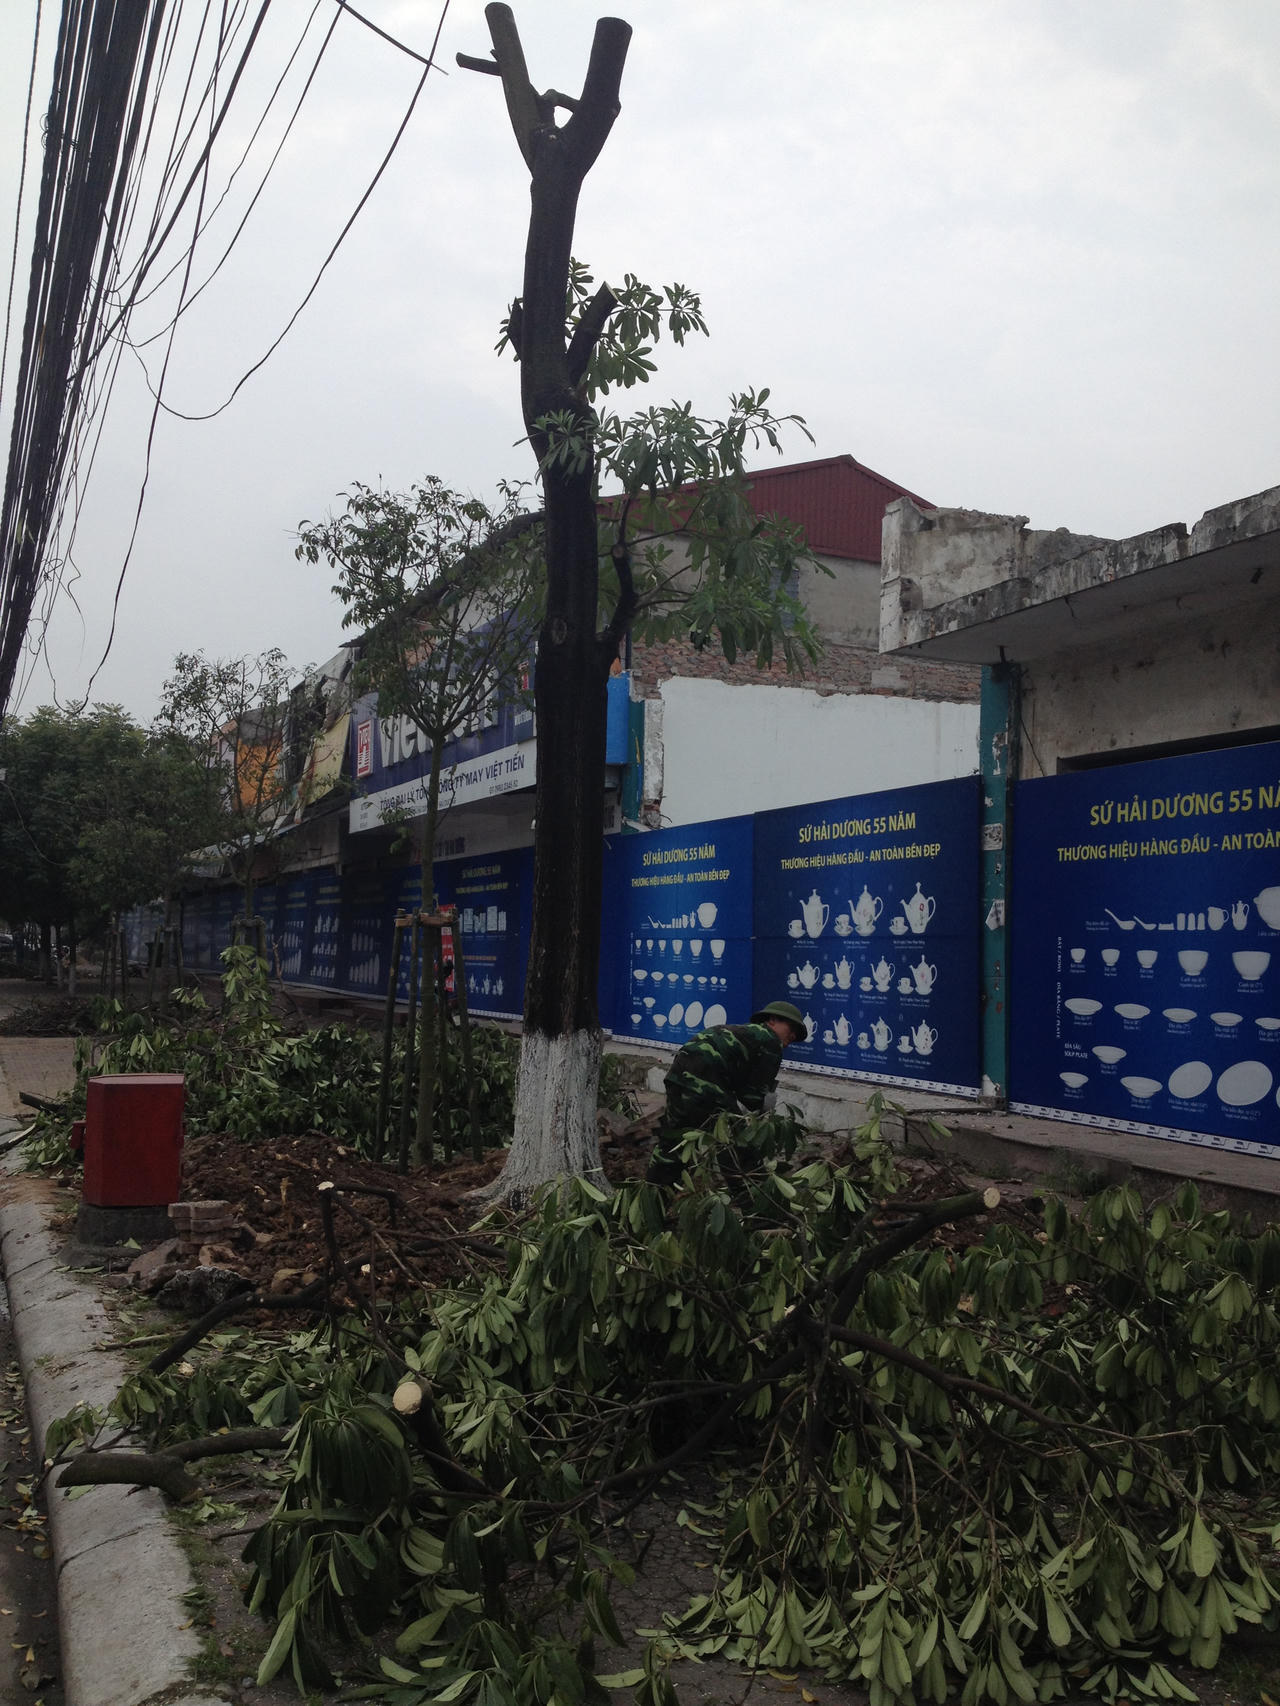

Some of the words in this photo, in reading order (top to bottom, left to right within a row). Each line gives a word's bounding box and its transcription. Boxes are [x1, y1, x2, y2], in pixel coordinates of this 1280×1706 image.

[465, 768, 483, 786] MAY
[485, 760, 503, 781] VIỆT
[505, 751, 525, 774] TIẾN
[1090, 800, 1114, 826] SỨ
[1117, 794, 1147, 824] HẢI
[1151, 792, 1223, 820] DƯƠNG
[1228, 788, 1253, 813] 55
[799, 823, 812, 843] SỨ
[813, 820, 831, 841] HẢI
[832, 818, 871, 840] DƯƠNG
[873, 816, 886, 834] 55
[888, 810, 916, 832] NĂM
[652, 848, 664, 865] HẢI
[664, 848, 688, 863] DƯƠNG
[689, 847, 698, 861] 55
[699, 843, 716, 859] NĂM
[781, 857, 809, 870] THƯƠNG
[809, 853, 826, 870] HIỆU
[826, 851, 847, 866] HÀNG
[869, 847, 882, 862] AN
[882, 845, 904, 860] TOÀN
[923, 843, 941, 860] ĐẸP
[1057, 843, 1106, 862] THƯƠNG
[1109, 840, 1138, 863] HIỆU
[1140, 837, 1178, 857] HÀNG
[1180, 832, 1211, 855] ĐẦU
[1221, 834, 1243, 852] AN
